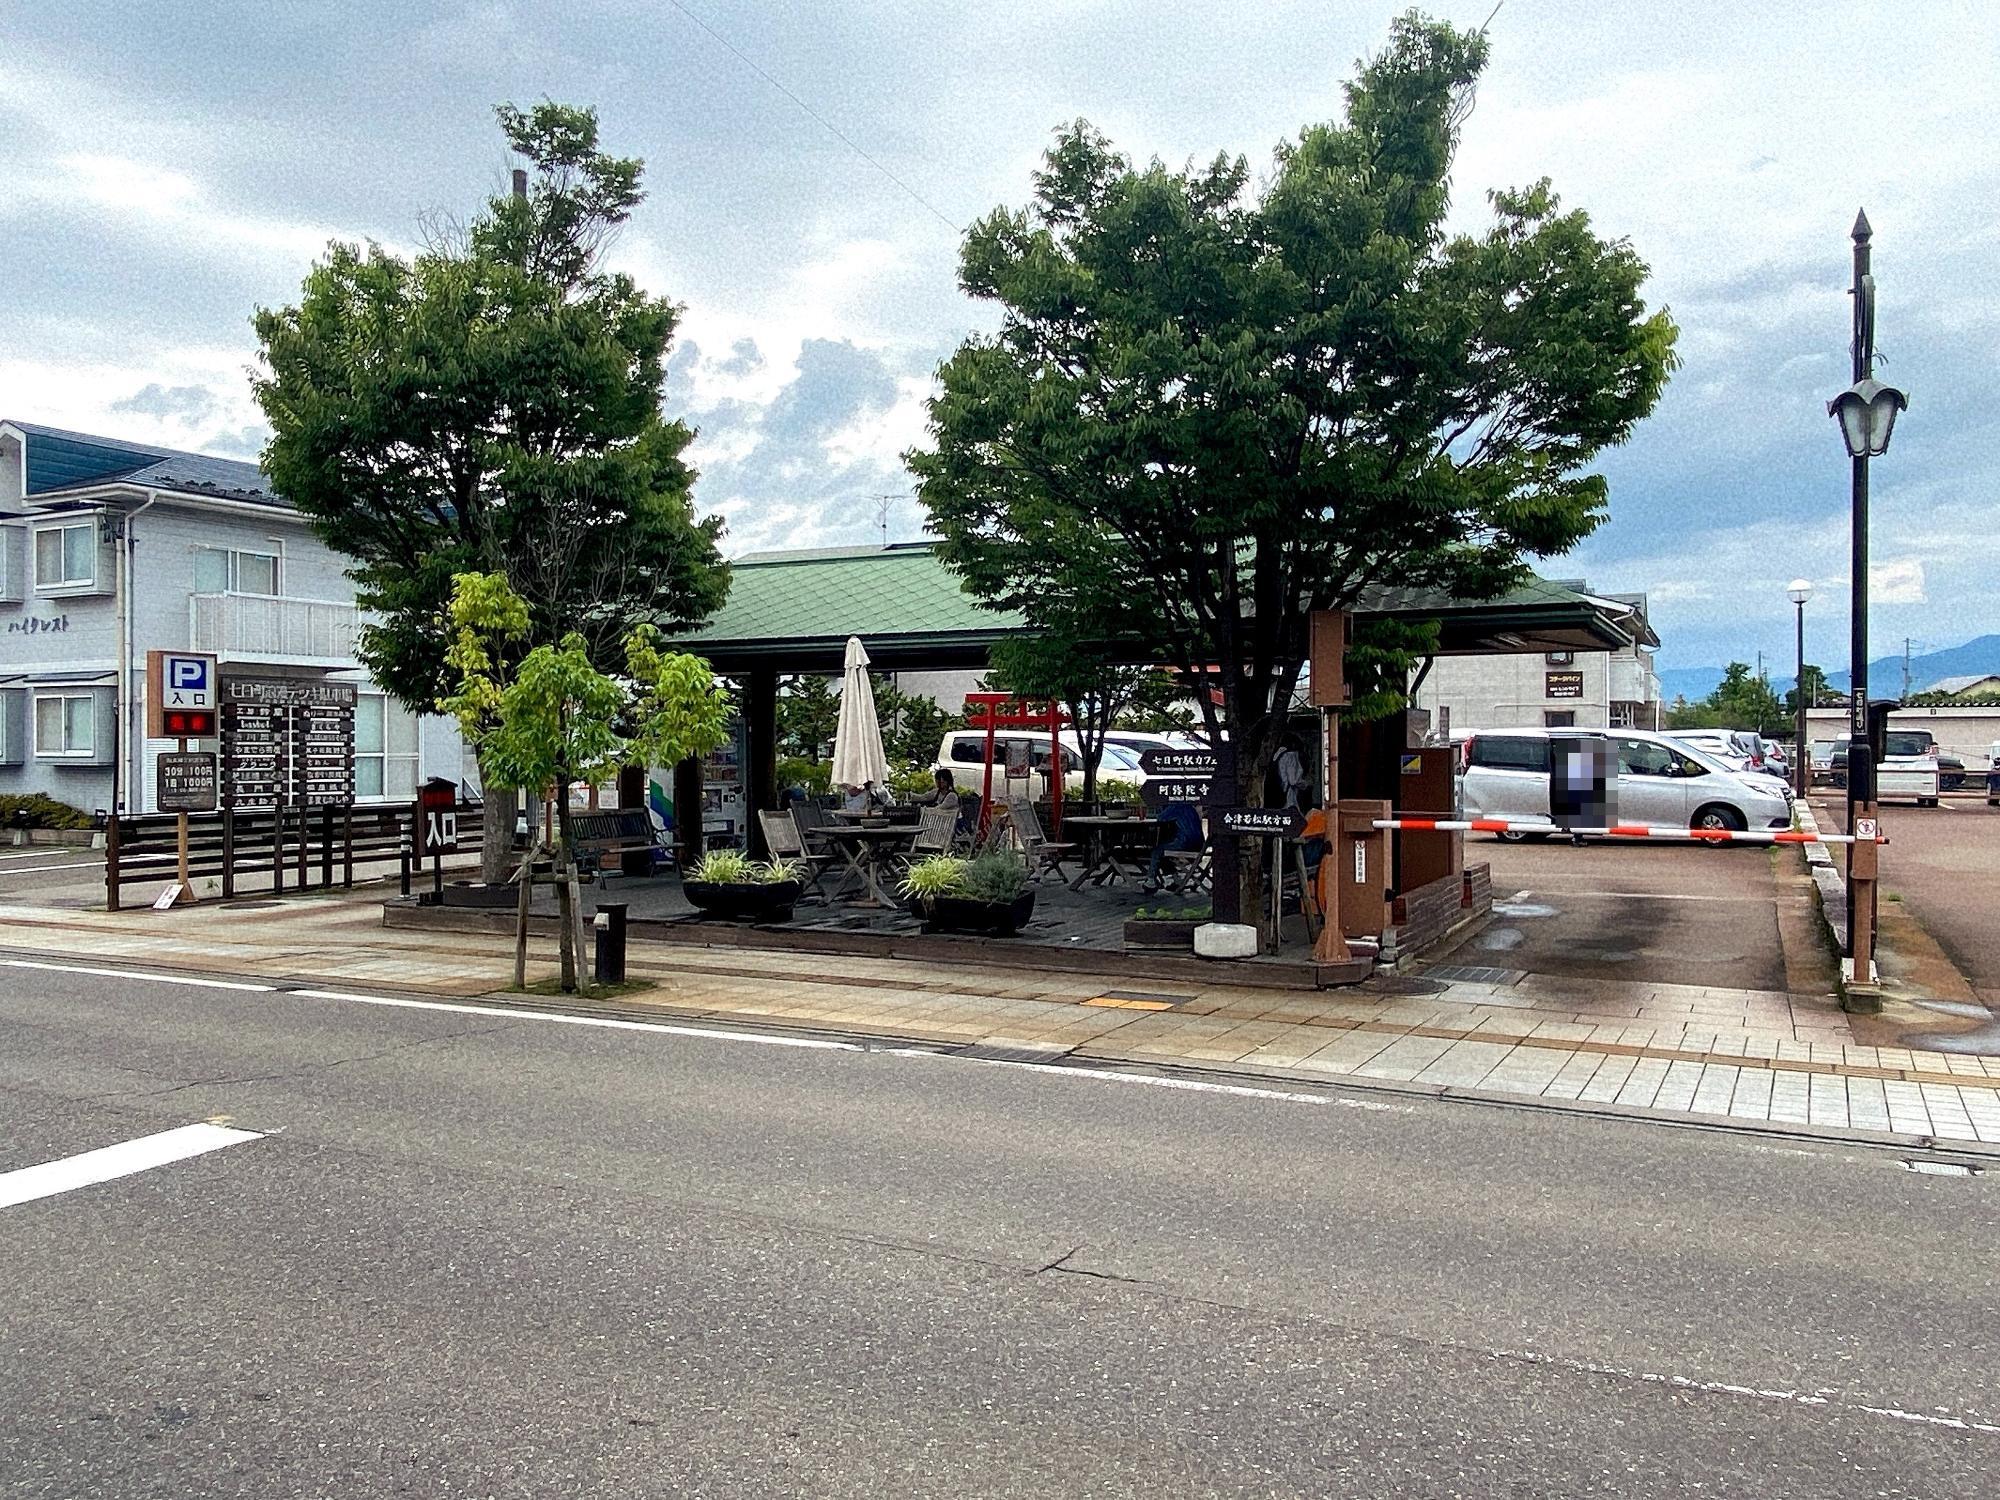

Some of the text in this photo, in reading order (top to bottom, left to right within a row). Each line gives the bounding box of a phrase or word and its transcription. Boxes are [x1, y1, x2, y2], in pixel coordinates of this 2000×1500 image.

[8, 614, 70, 635] ハイクレスト
[174, 661, 203, 688] P
[172, 693, 206, 706] 入口
[1152, 755, 1218, 767] 七日町駅カフェ
[1159, 783, 1210, 796] 阿弥陀寺
[1223, 813, 1292, 826] 会津若松駅方面
[426, 812, 457, 848] 入口
